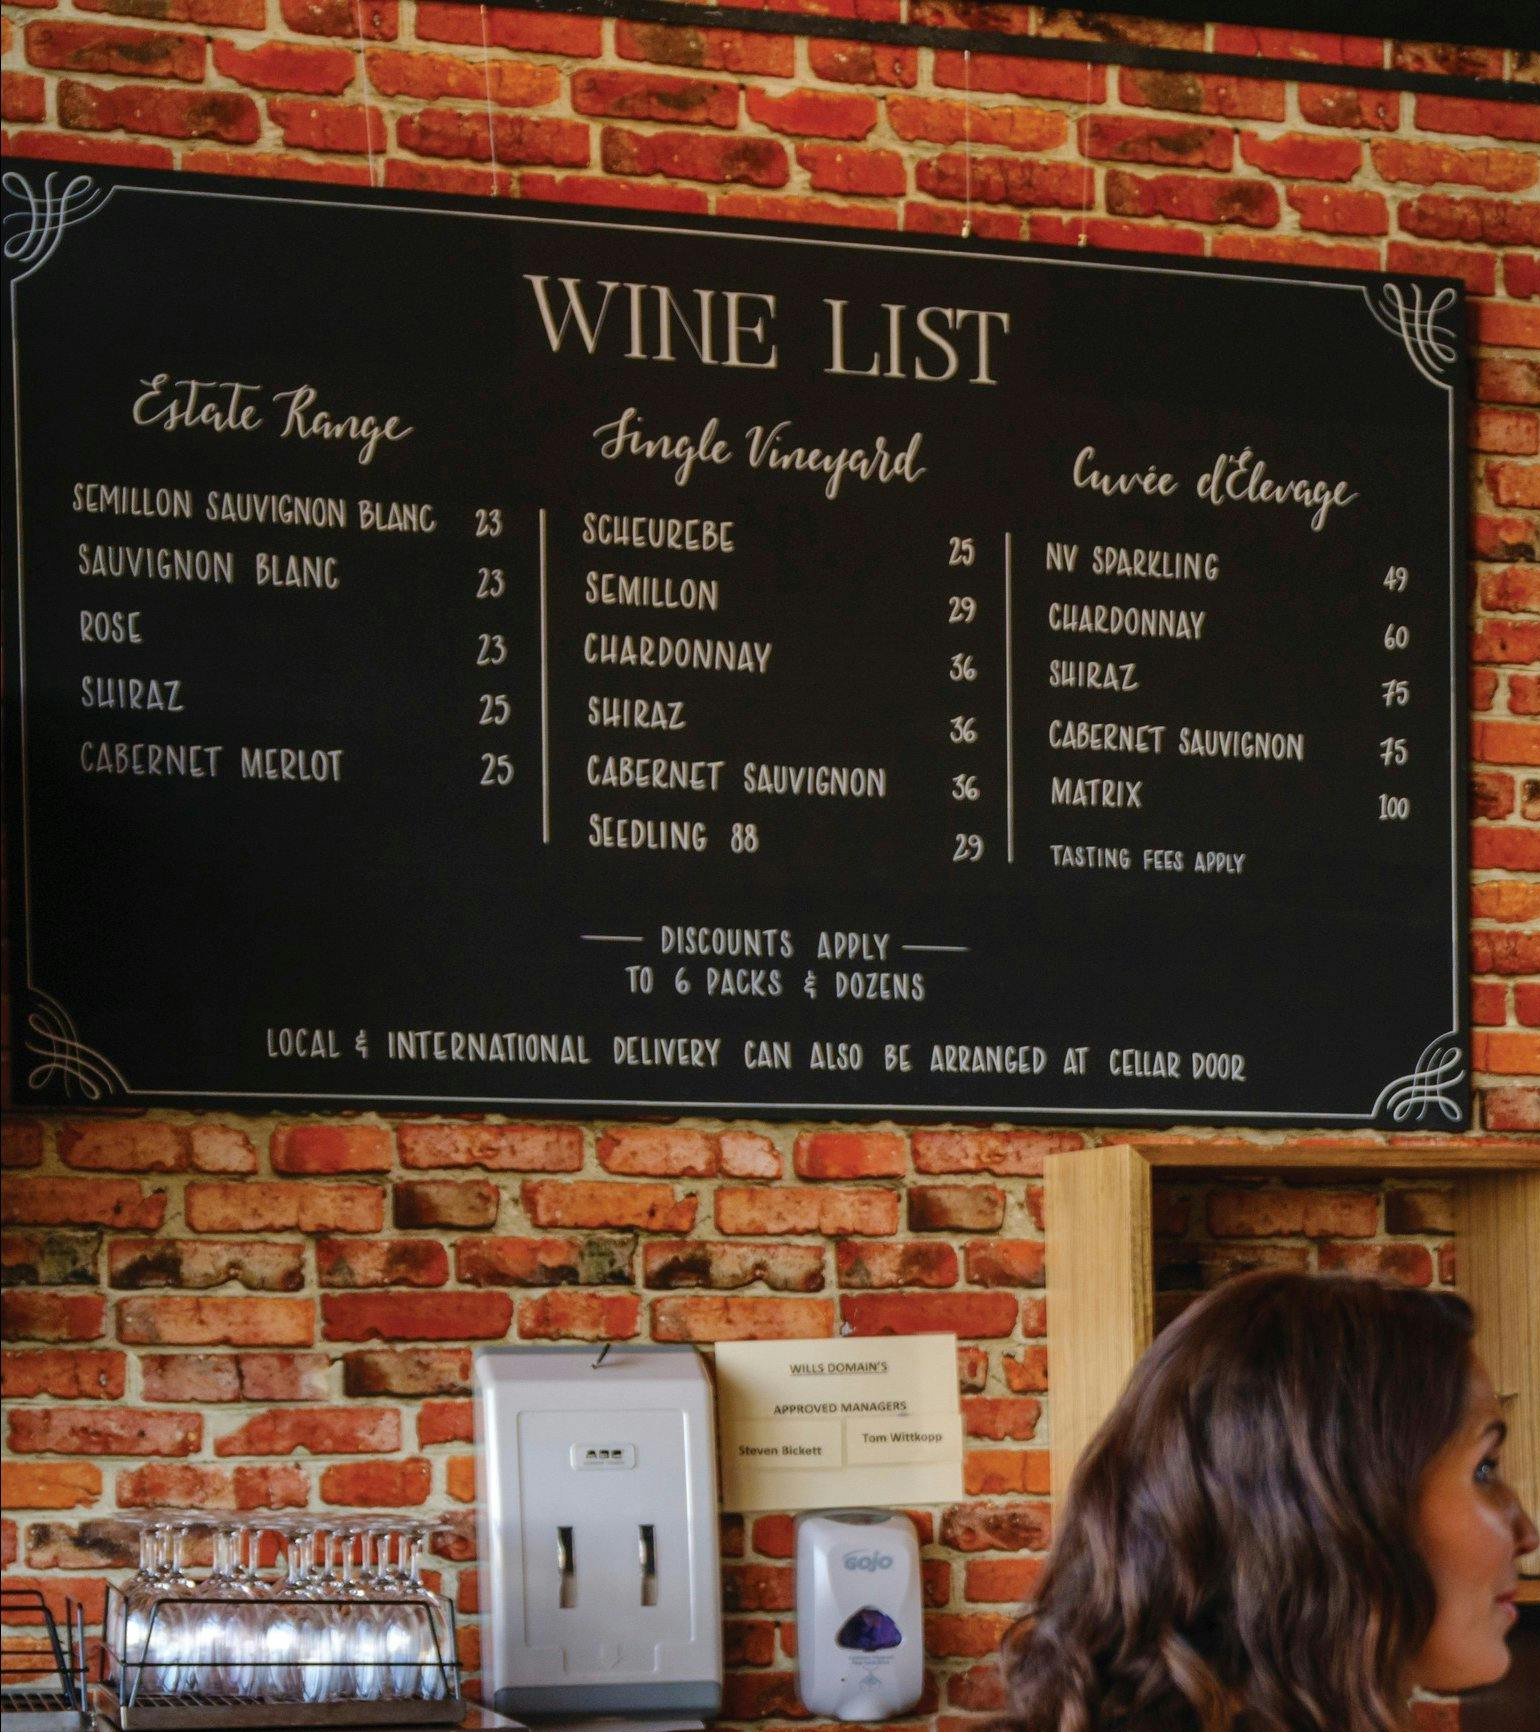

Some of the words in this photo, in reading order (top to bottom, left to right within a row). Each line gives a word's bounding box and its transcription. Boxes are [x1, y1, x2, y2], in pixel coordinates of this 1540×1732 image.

[524, 275, 776, 368] WINE
[824, 299, 1009, 384] LIST
[133, 374, 261, 431] Estate
[273, 385, 412, 464] Range
[593, 407, 731, 486] Single
[746, 421, 925, 499] Vineyard
[1073, 446, 1177, 495] Cuvée
[73, 483, 191, 518] SEMILLON
[206, 491, 346, 527] SAUVIGNON
[358, 500, 436, 532] BLANC
[476, 509, 502, 536] 23
[583, 512, 733, 552] SCHEUREBE
[79, 544, 232, 583] SAUVIGNON
[256, 553, 338, 589] BLANC
[949, 537, 974, 565] 25
[1047, 543, 1078, 571] NV
[1092, 546, 1218, 580] SPARKLING
[476, 568, 504, 598] 23
[586, 571, 717, 610] SEMILLON
[1384, 566, 1408, 591] 49
[949, 596, 976, 623] 29
[1049, 603, 1204, 639] CHARDONNAY
[80, 611, 142, 643] ROSE
[1384, 624, 1409, 650] 60
[477, 634, 506, 665] 23
[584, 633, 771, 673] CHARDONNAY
[950, 653, 977, 681] 36
[1050, 660, 1138, 691] SHIRAZ
[82, 676, 183, 711] SHIRAZ
[1382, 679, 1409, 706] 75
[479, 694, 510, 725] 25
[588, 696, 685, 729] SHIRAZ
[950, 716, 977, 743] 36
[1049, 720, 1165, 753] CABERNET
[1179, 727, 1303, 760] SAUVIGNON
[81, 742, 222, 777] CABERNET
[242, 748, 342, 781] MERLOT
[1380, 737, 1407, 765] 75
[480, 753, 514, 785] 25
[587, 755, 724, 790] CABERNET
[744, 762, 885, 797] SAUVIGNON
[952, 774, 979, 800] 36
[1052, 777, 1141, 807] MATRIX
[1379, 794, 1409, 820] 100
[589, 814, 707, 851] SEEDLING
[731, 823, 758, 853] 88
[953, 834, 983, 861] 29
[1050, 845, 1130, 869] TASTING
[1144, 849, 1183, 871] FEES
[1195, 851, 1245, 873] APPLY
[662, 926, 793, 957] DISCOUNTS
[818, 932, 889, 960] APPLY
[625, 965, 653, 993] TO
[675, 967, 690, 994] 6
[707, 967, 782, 996] PACKS
[804, 970, 816, 999] &
[836, 972, 924, 1001] DOZENS
[267, 1028, 340, 1058] LOCAL
[355, 1030, 367, 1058] &
[389, 1031, 589, 1064] INTERNATIONAL
[614, 1036, 720, 1067] DELIVERY
[744, 1041, 791, 1069] CAN
[810, 1042, 862, 1070] ALSO
[885, 1044, 911, 1072] BE
[931, 1045, 1046, 1074] ARRANGED
[1064, 1047, 1088, 1074] AT
[1110, 1049, 1180, 1078] CELLAR
[1192, 1052, 1245, 1081] DOOR
[789, 1362, 824, 1374] WILLS
[827, 1361, 888, 1373] DOMAIN'S
[773, 1402, 837, 1415] APPROVED
[840, 1400, 907, 1413] MANAGERS
[738, 1445, 778, 1456] Steven
[782, 1444, 822, 1455] Bickett
[862, 1432, 887, 1443] Tom
[890, 1431, 943, 1443] Wittkopp
